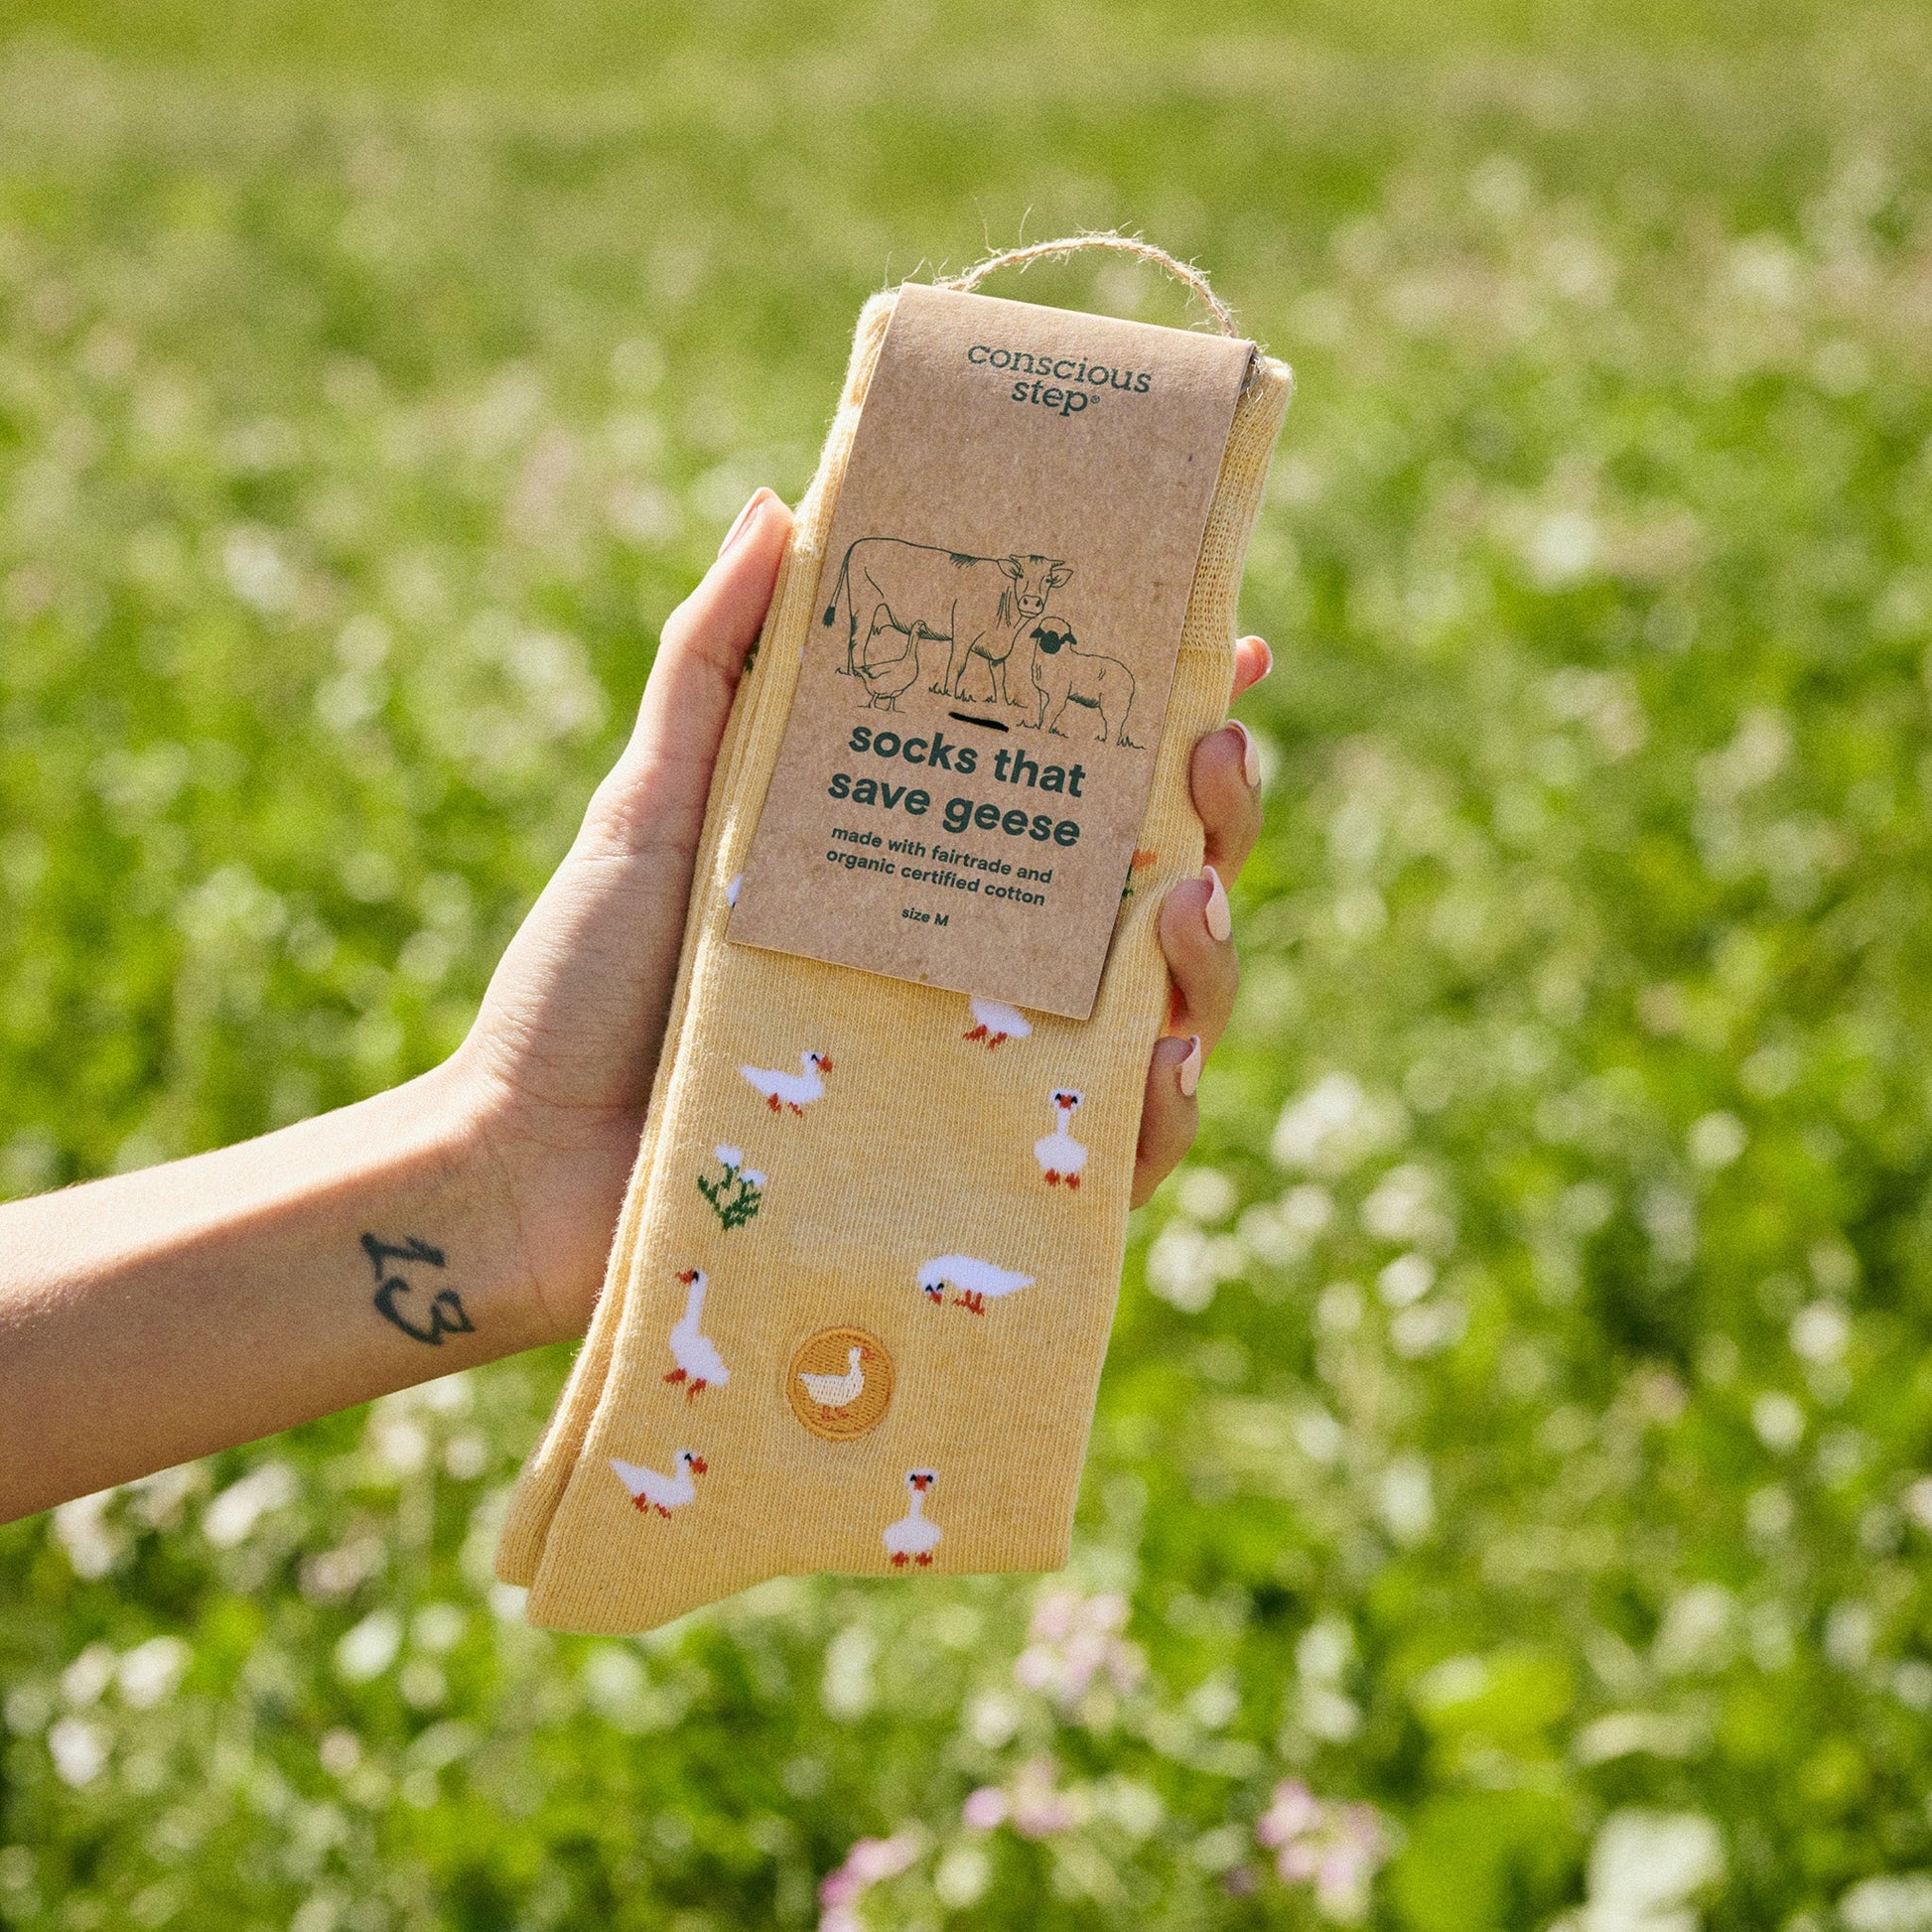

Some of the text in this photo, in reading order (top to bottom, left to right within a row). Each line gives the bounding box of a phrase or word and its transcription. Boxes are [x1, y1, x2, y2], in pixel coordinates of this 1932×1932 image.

[968, 345, 1152, 393] conscious
[849, 726, 1086, 797] socks that
[828, 773, 1081, 846] save geese
[826, 849, 1045, 905] organic certified cotton
[831, 826, 1052, 884] made with fairtrade and
[901, 906, 949, 926] size M
[361, 1233, 476, 1345] 13
